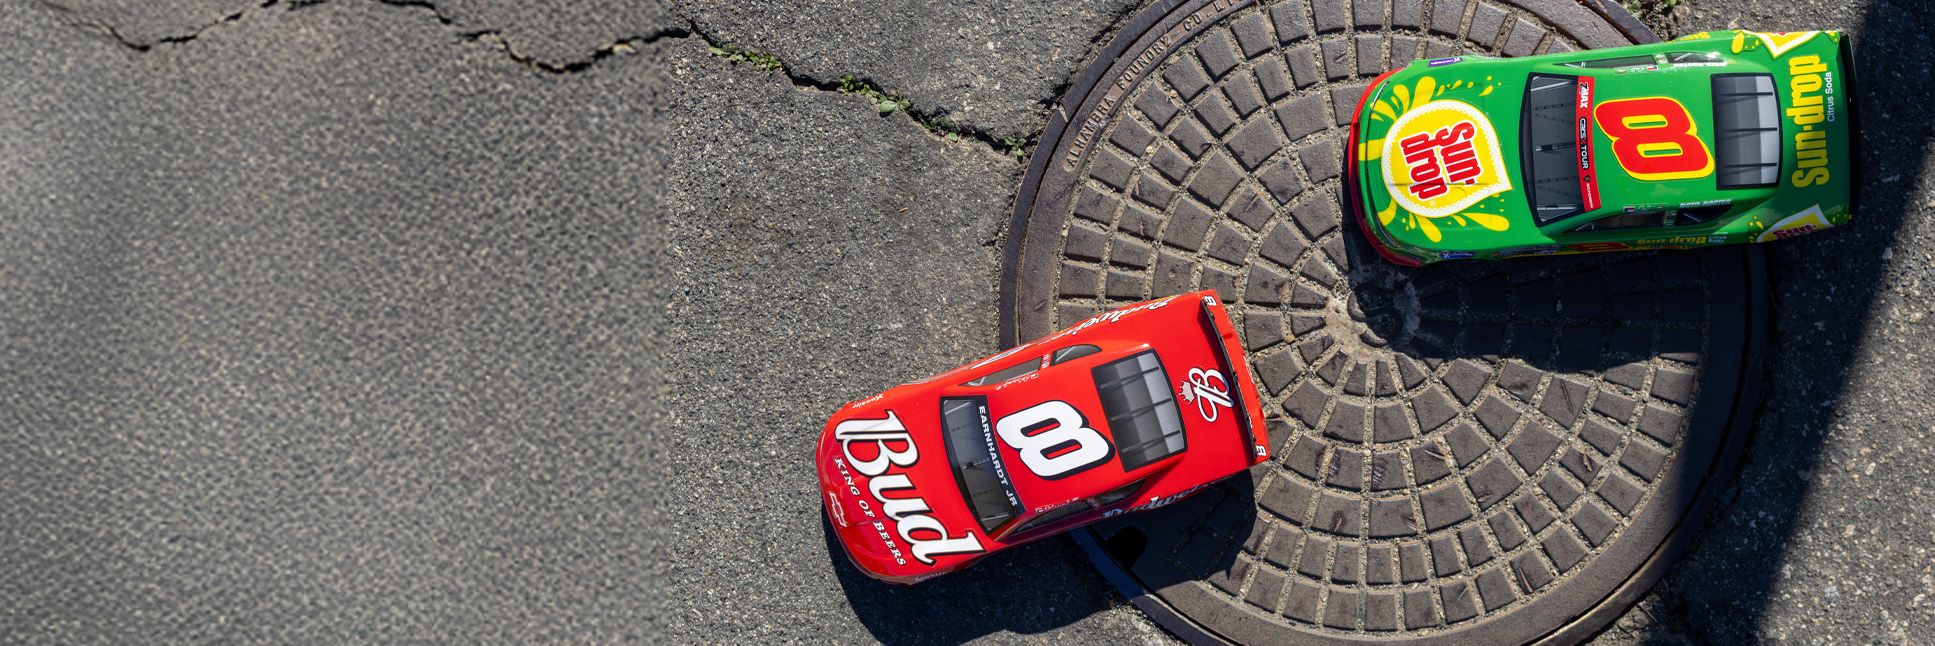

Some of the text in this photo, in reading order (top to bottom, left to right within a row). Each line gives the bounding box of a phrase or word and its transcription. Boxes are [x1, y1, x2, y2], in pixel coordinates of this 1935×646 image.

[1066, 97, 1116, 168] ALHAMBRA
[1116, 34, 1174, 91] FOUNDRY
[1824, 71, 1836, 122] Citrus Soda
[1400, 131, 1449, 201] drop
[1581, 145, 1589, 169] TOUR
[1594, 96, 1715, 181] 8
[1204, 295, 1217, 307] 8
[979, 405, 1019, 507] EARNHARDT JR
[996, 400, 1116, 481] 8
[1256, 444, 1267, 457] 8
[834, 409, 987, 567] Bud
[834, 456, 907, 566] KING OF BEERS
